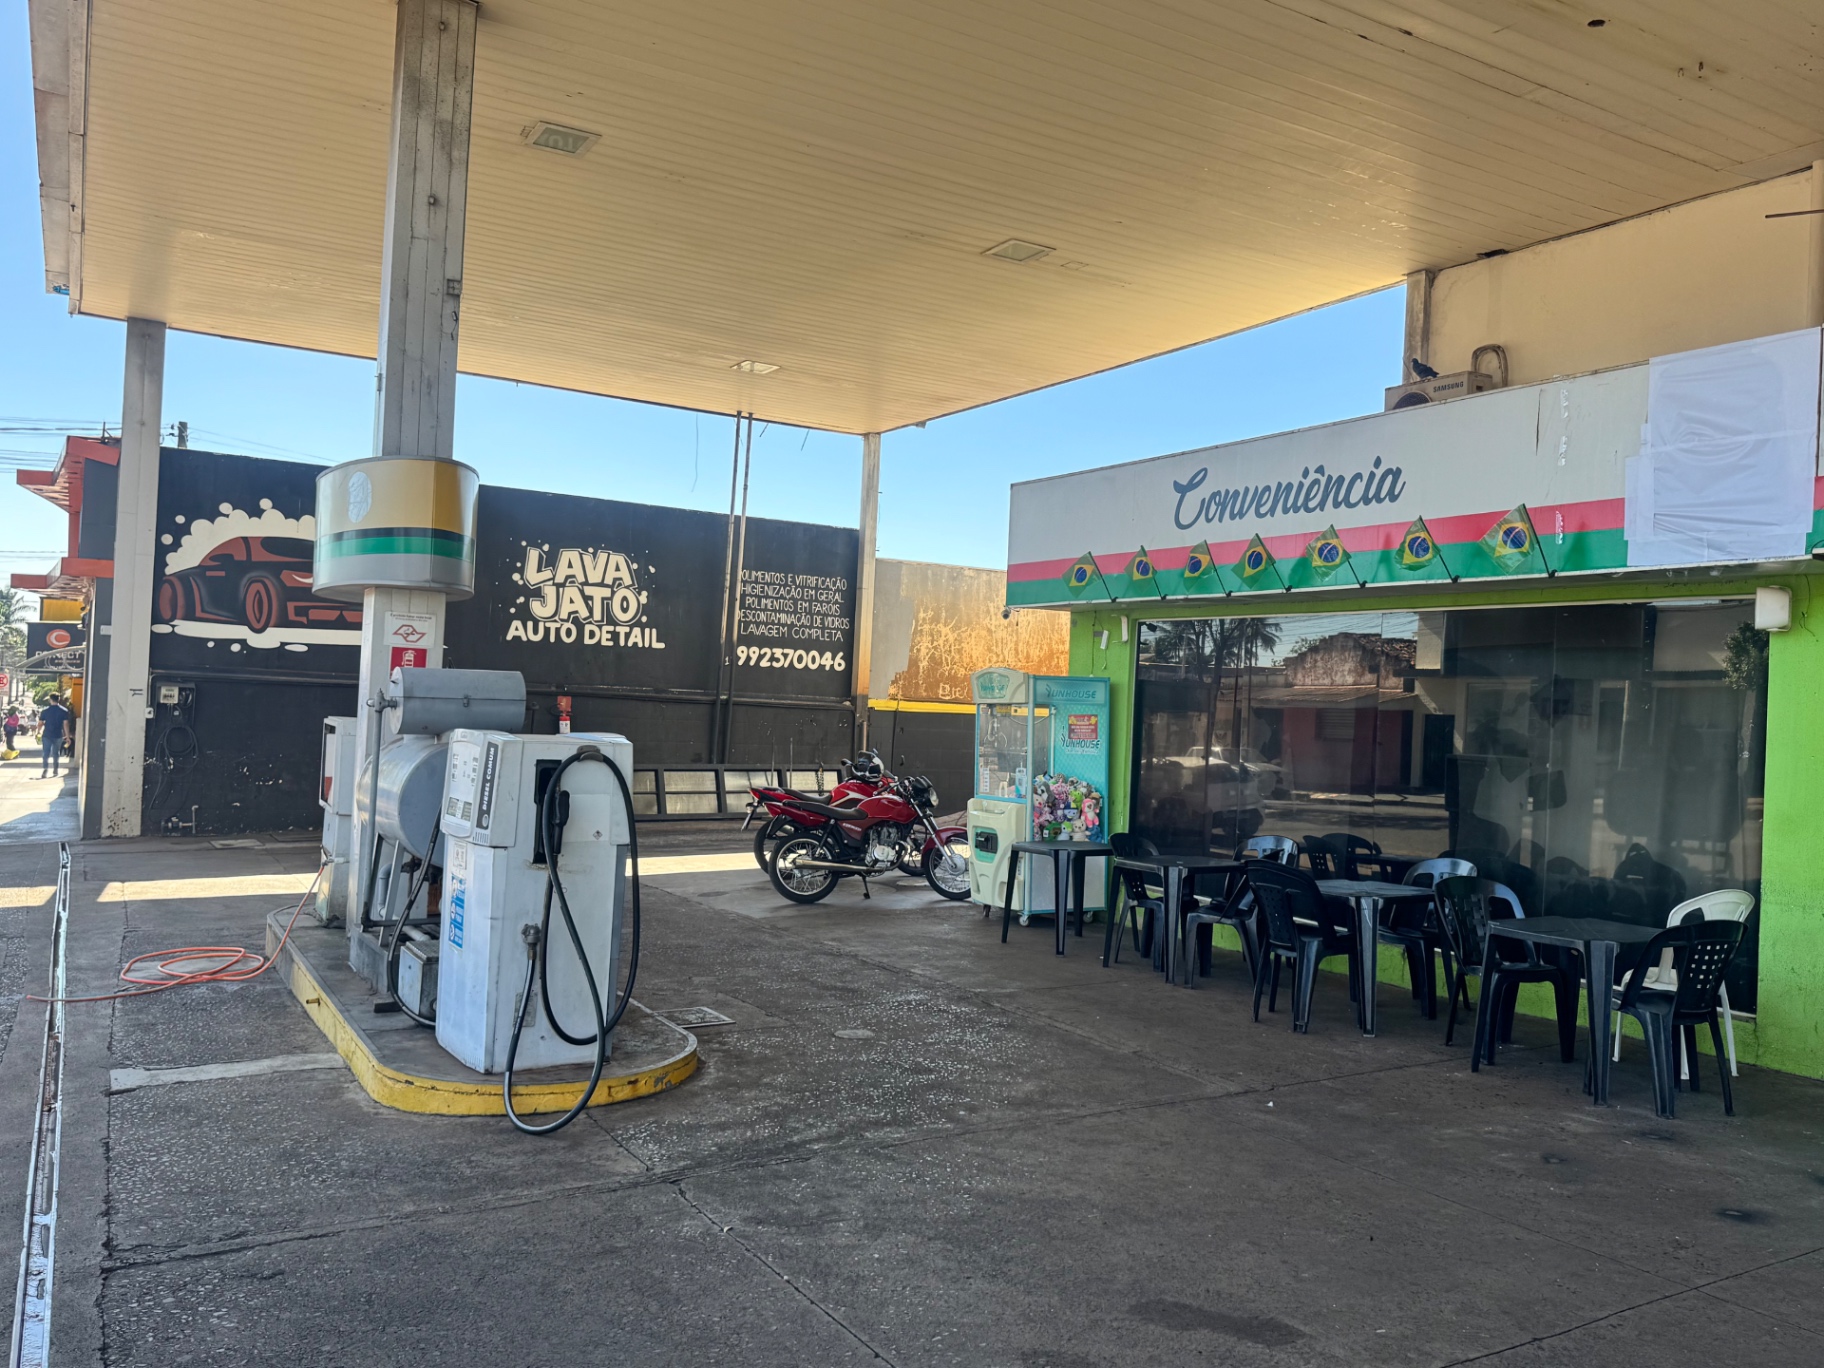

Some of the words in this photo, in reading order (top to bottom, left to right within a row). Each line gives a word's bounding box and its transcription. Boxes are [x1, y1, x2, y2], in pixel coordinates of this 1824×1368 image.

[1433, 381, 1464, 393] SAMSUNG
[1173, 455, 1407, 530] Conveniência
[525, 547, 637, 589] LAVA
[741, 570, 786, 585] OLIMENTOS
[788, 574, 794, 585] E
[795, 575, 847, 591] VITRIFICAÇÃO
[530, 583, 642, 625] JATO
[741, 583, 802, 599] HIGIENIZAÇÃO
[804, 589, 815, 600] EM
[817, 590, 845, 603] GERAL
[745, 597, 794, 612] POLIMENTOS
[798, 601, 809, 613] EM
[740, 623, 788, 638] LAVAGEM
[792, 627, 844, 642] COMPLETA
[813, 615, 823, 627] DE
[824, 617, 850, 630] VIDROS
[506, 620, 577, 644] AUTO
[584, 624, 666, 649] DETAIL
[736, 646, 846, 671] 992370046
[482, 782, 490, 811] DIESEL
[486, 747, 495, 780] COMUM
